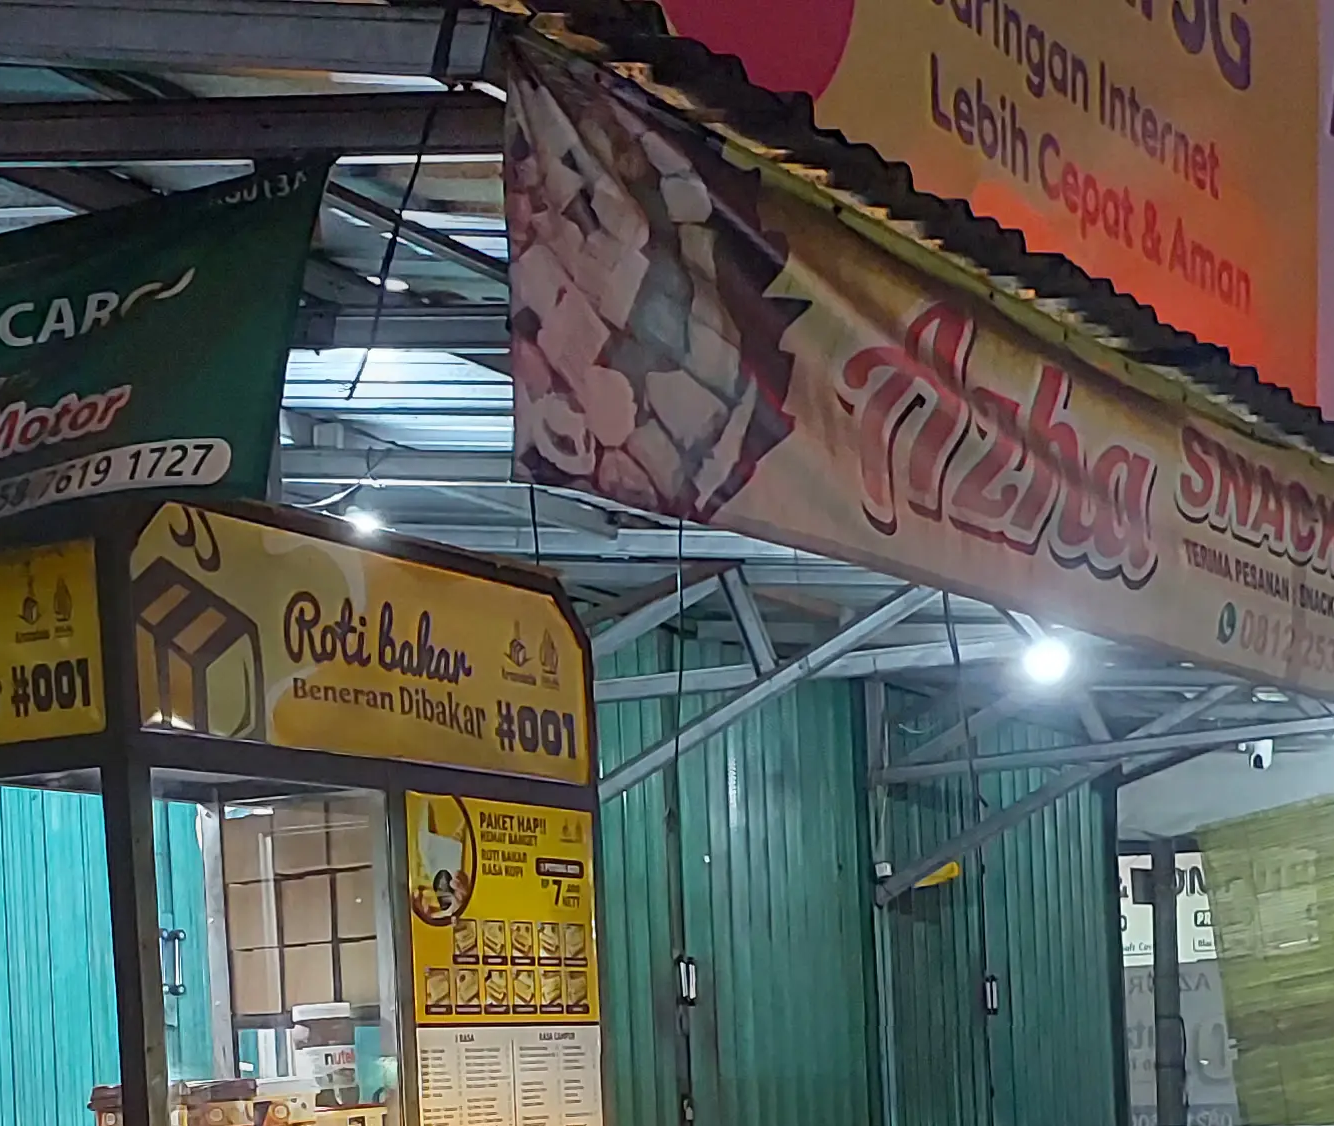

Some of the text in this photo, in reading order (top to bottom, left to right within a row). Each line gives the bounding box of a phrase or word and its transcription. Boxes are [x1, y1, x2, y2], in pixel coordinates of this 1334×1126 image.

[1098, 59, 1221, 200] Internet
[930, 52, 1253, 313] Lebih Cepat & Aman
[37, 455, 113, 499] 7619
[128, 443, 215, 481] 1727
[835, 296, 1157, 589] Azha
[1183, 537, 1233, 584] TERIMA
[1234, 560, 1290, 604] PESANAN
[283, 590, 473, 687] Roti bakar
[1239, 608, 1294, 664] 0812
[10, 657, 92, 718] #001
[292, 675, 577, 760] Beneran Dibakar #001
[479, 811, 515, 831] PAKET
[552, 879, 563, 906] 7
